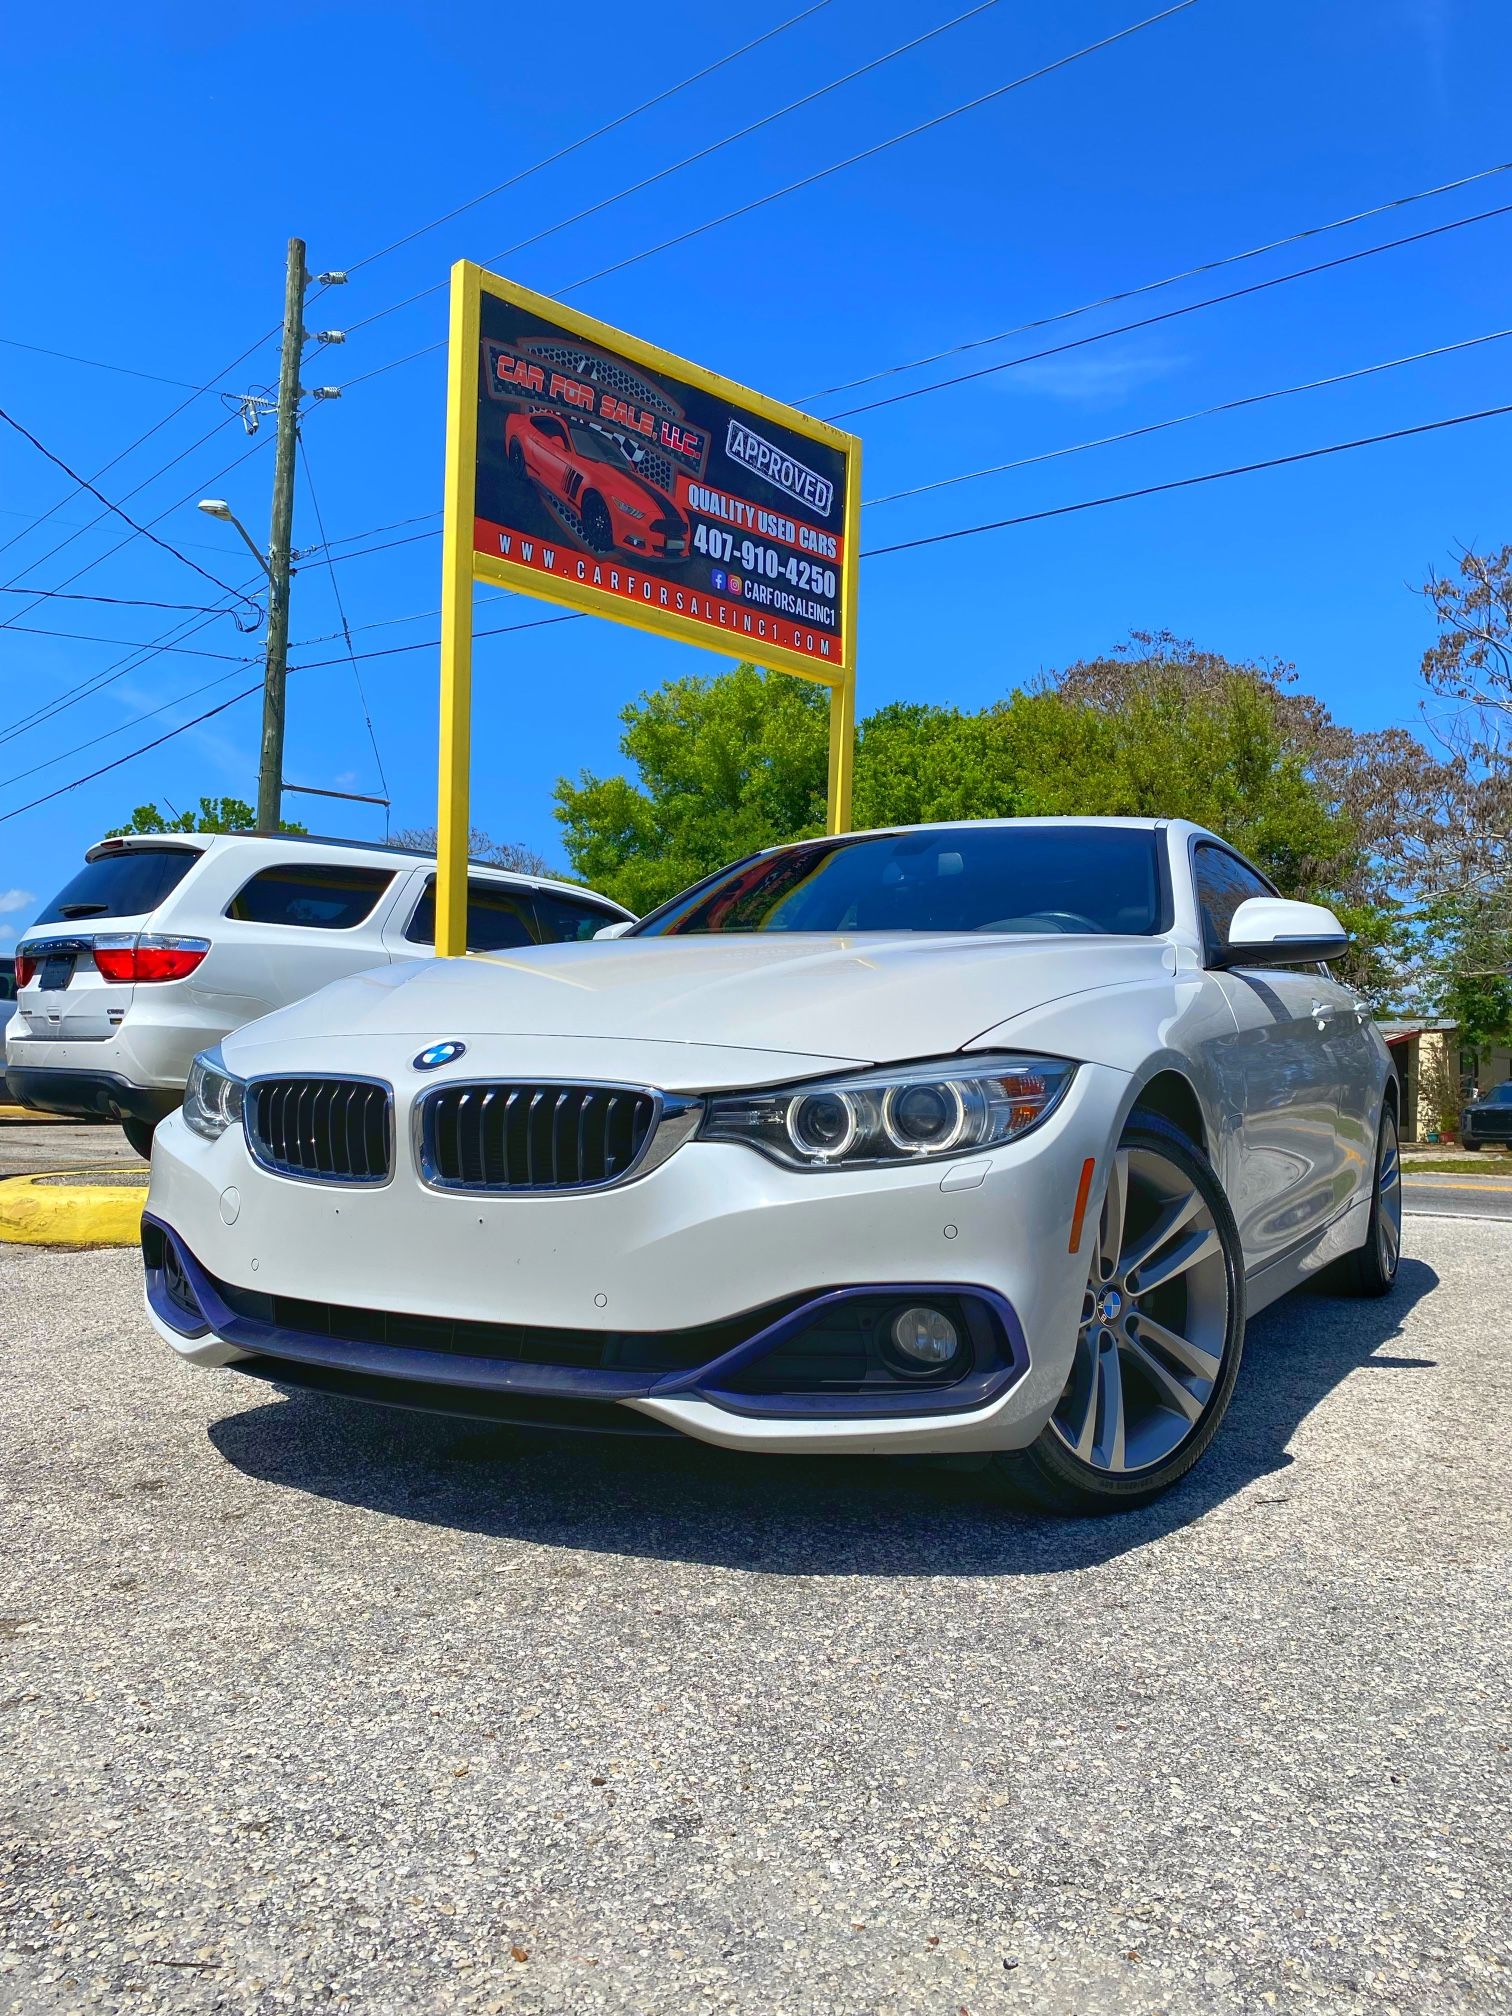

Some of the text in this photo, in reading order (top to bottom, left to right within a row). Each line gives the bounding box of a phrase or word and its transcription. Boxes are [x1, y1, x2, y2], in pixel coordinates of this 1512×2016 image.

[497, 354, 701, 460] CAR FOR SALE, LLC.
[731, 431, 827, 507] APPROVED
[688, 483, 837, 559] QUALITY USED CARS
[693, 523, 836, 599] 407-910-4250
[744, 579, 836, 627] CARFORSALEINC1
